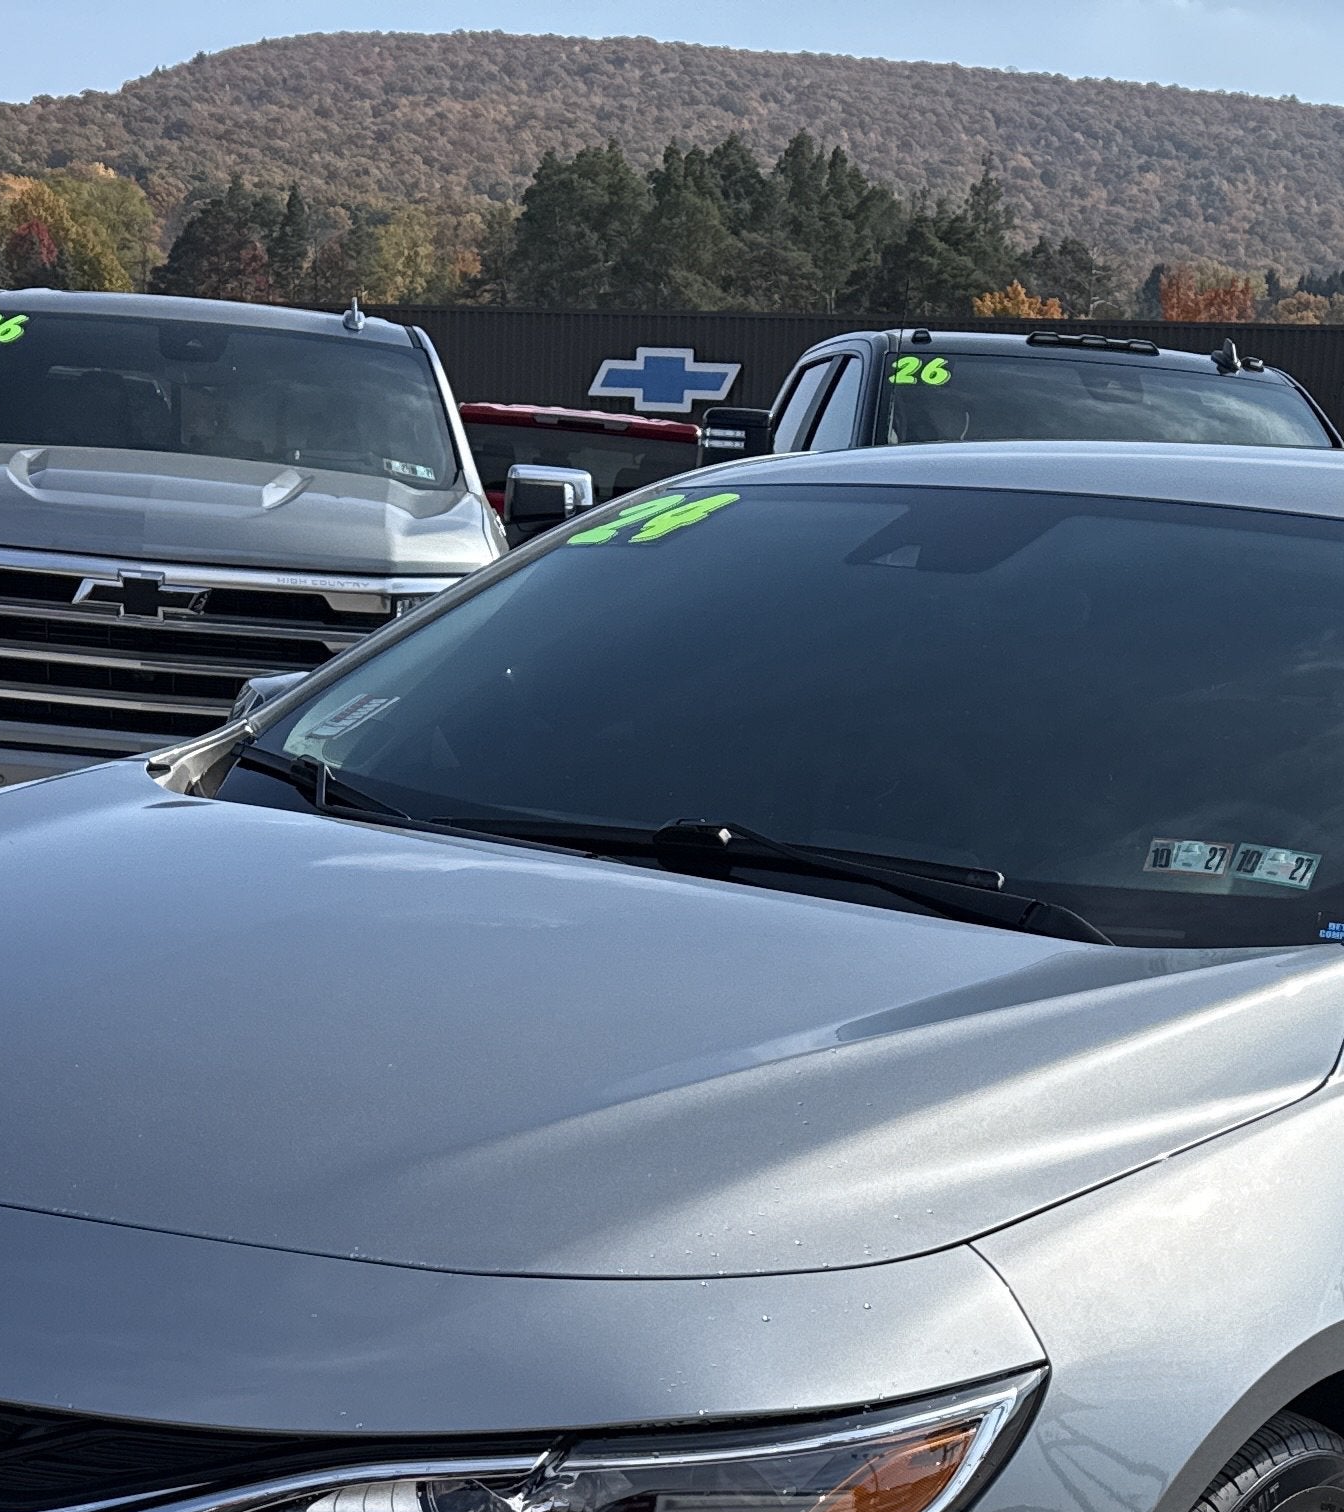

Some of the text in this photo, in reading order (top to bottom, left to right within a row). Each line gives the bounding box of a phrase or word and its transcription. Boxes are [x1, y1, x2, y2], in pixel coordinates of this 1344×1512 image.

[889, 356, 952, 386] 26
[566, 492, 741, 545] 24
[276, 577, 370, 588] HIGH COUNTRY
[1205, 846, 1227, 872] 27
[1288, 856, 1314, 882] 27
